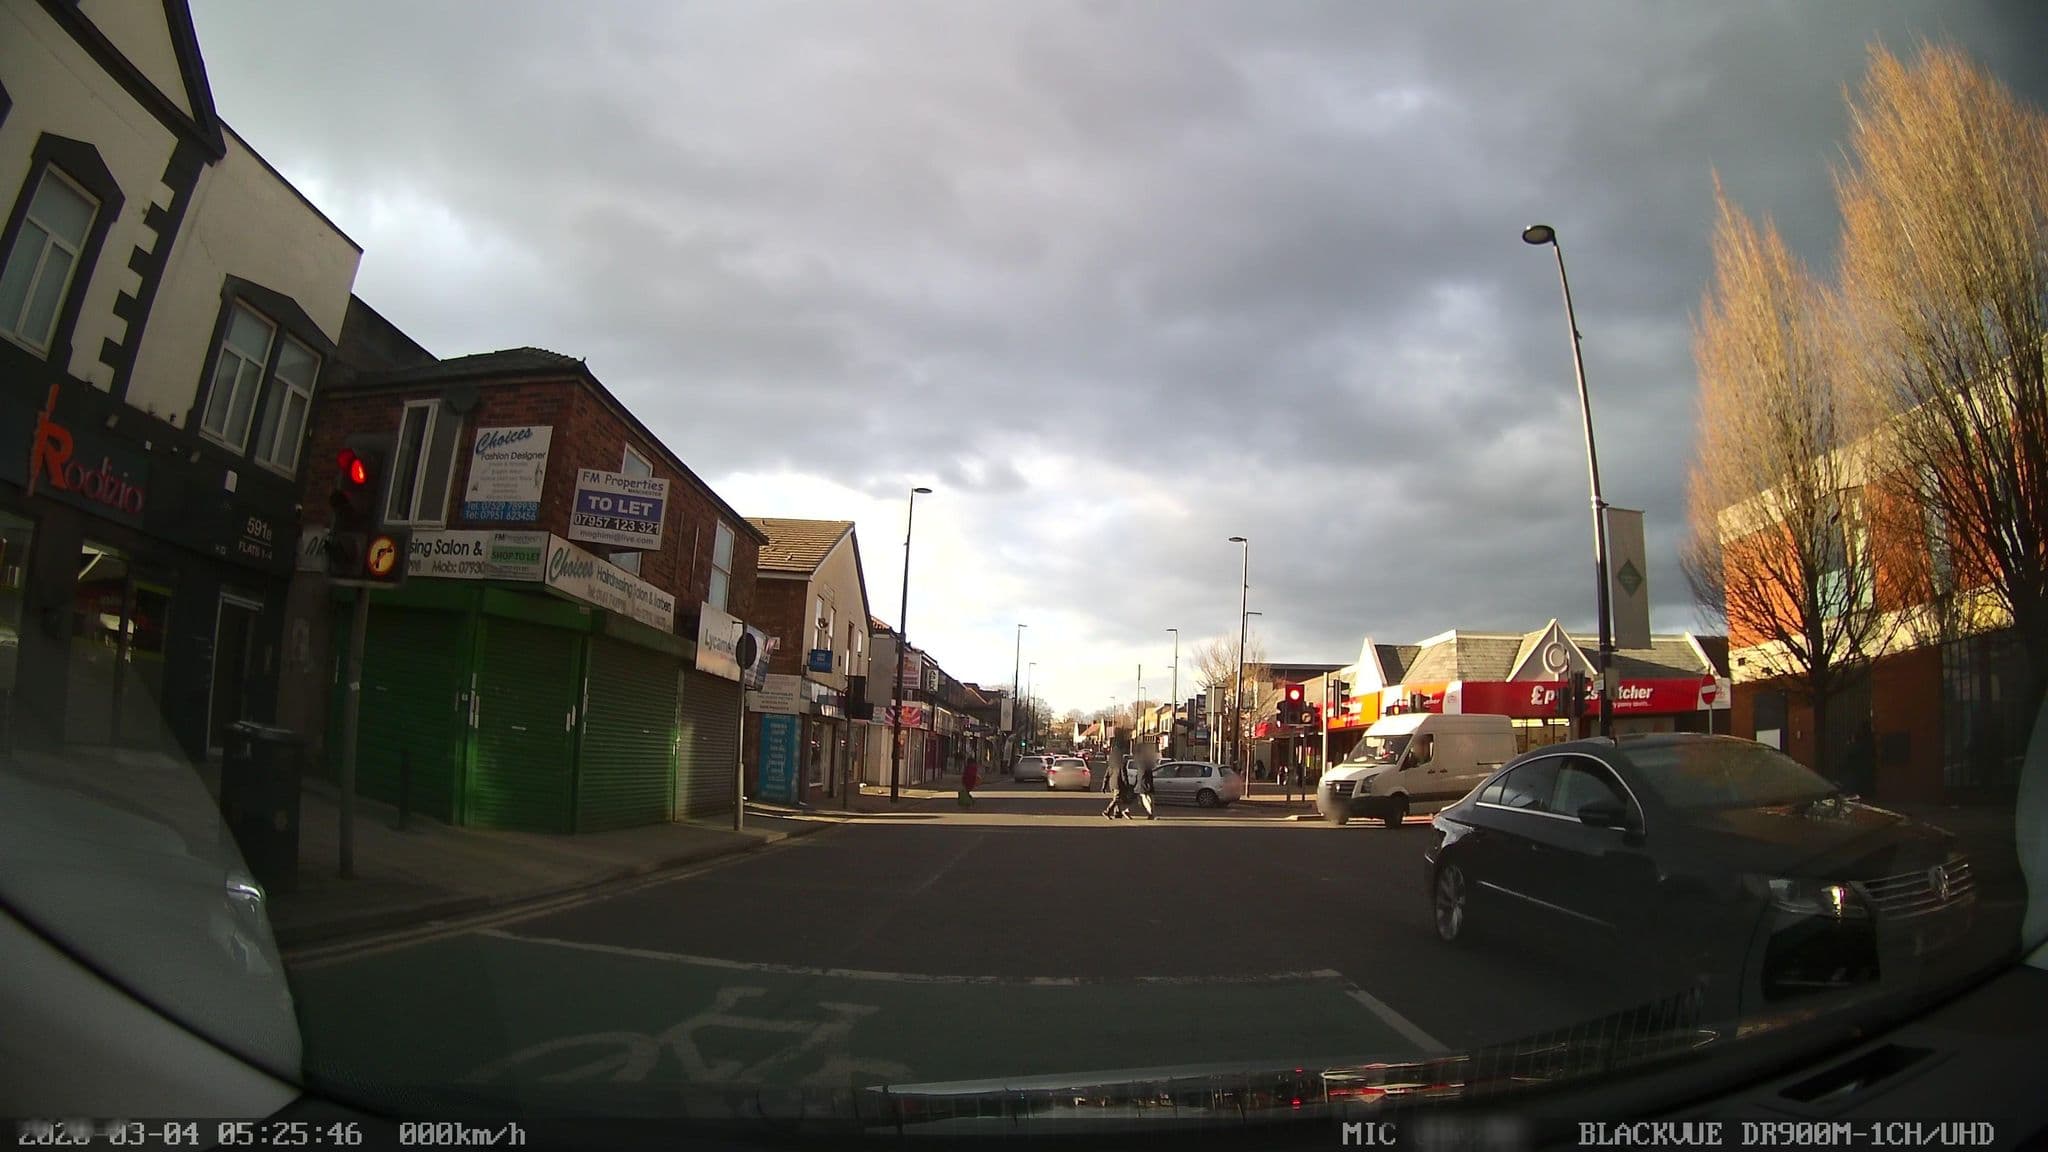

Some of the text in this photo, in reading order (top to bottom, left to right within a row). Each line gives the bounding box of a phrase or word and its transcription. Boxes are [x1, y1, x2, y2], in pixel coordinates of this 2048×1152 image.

[475, 427, 533, 455] Choices
[511, 451, 546, 461] Designer
[583, 471, 664, 491] FM Properties
[588, 495, 653, 516] TO LET
[574, 514, 660, 534] 07957 123 321
[434, 538, 469, 556] Salon
[473, 540, 482, 556] &
[549, 547, 594, 583] Choices
